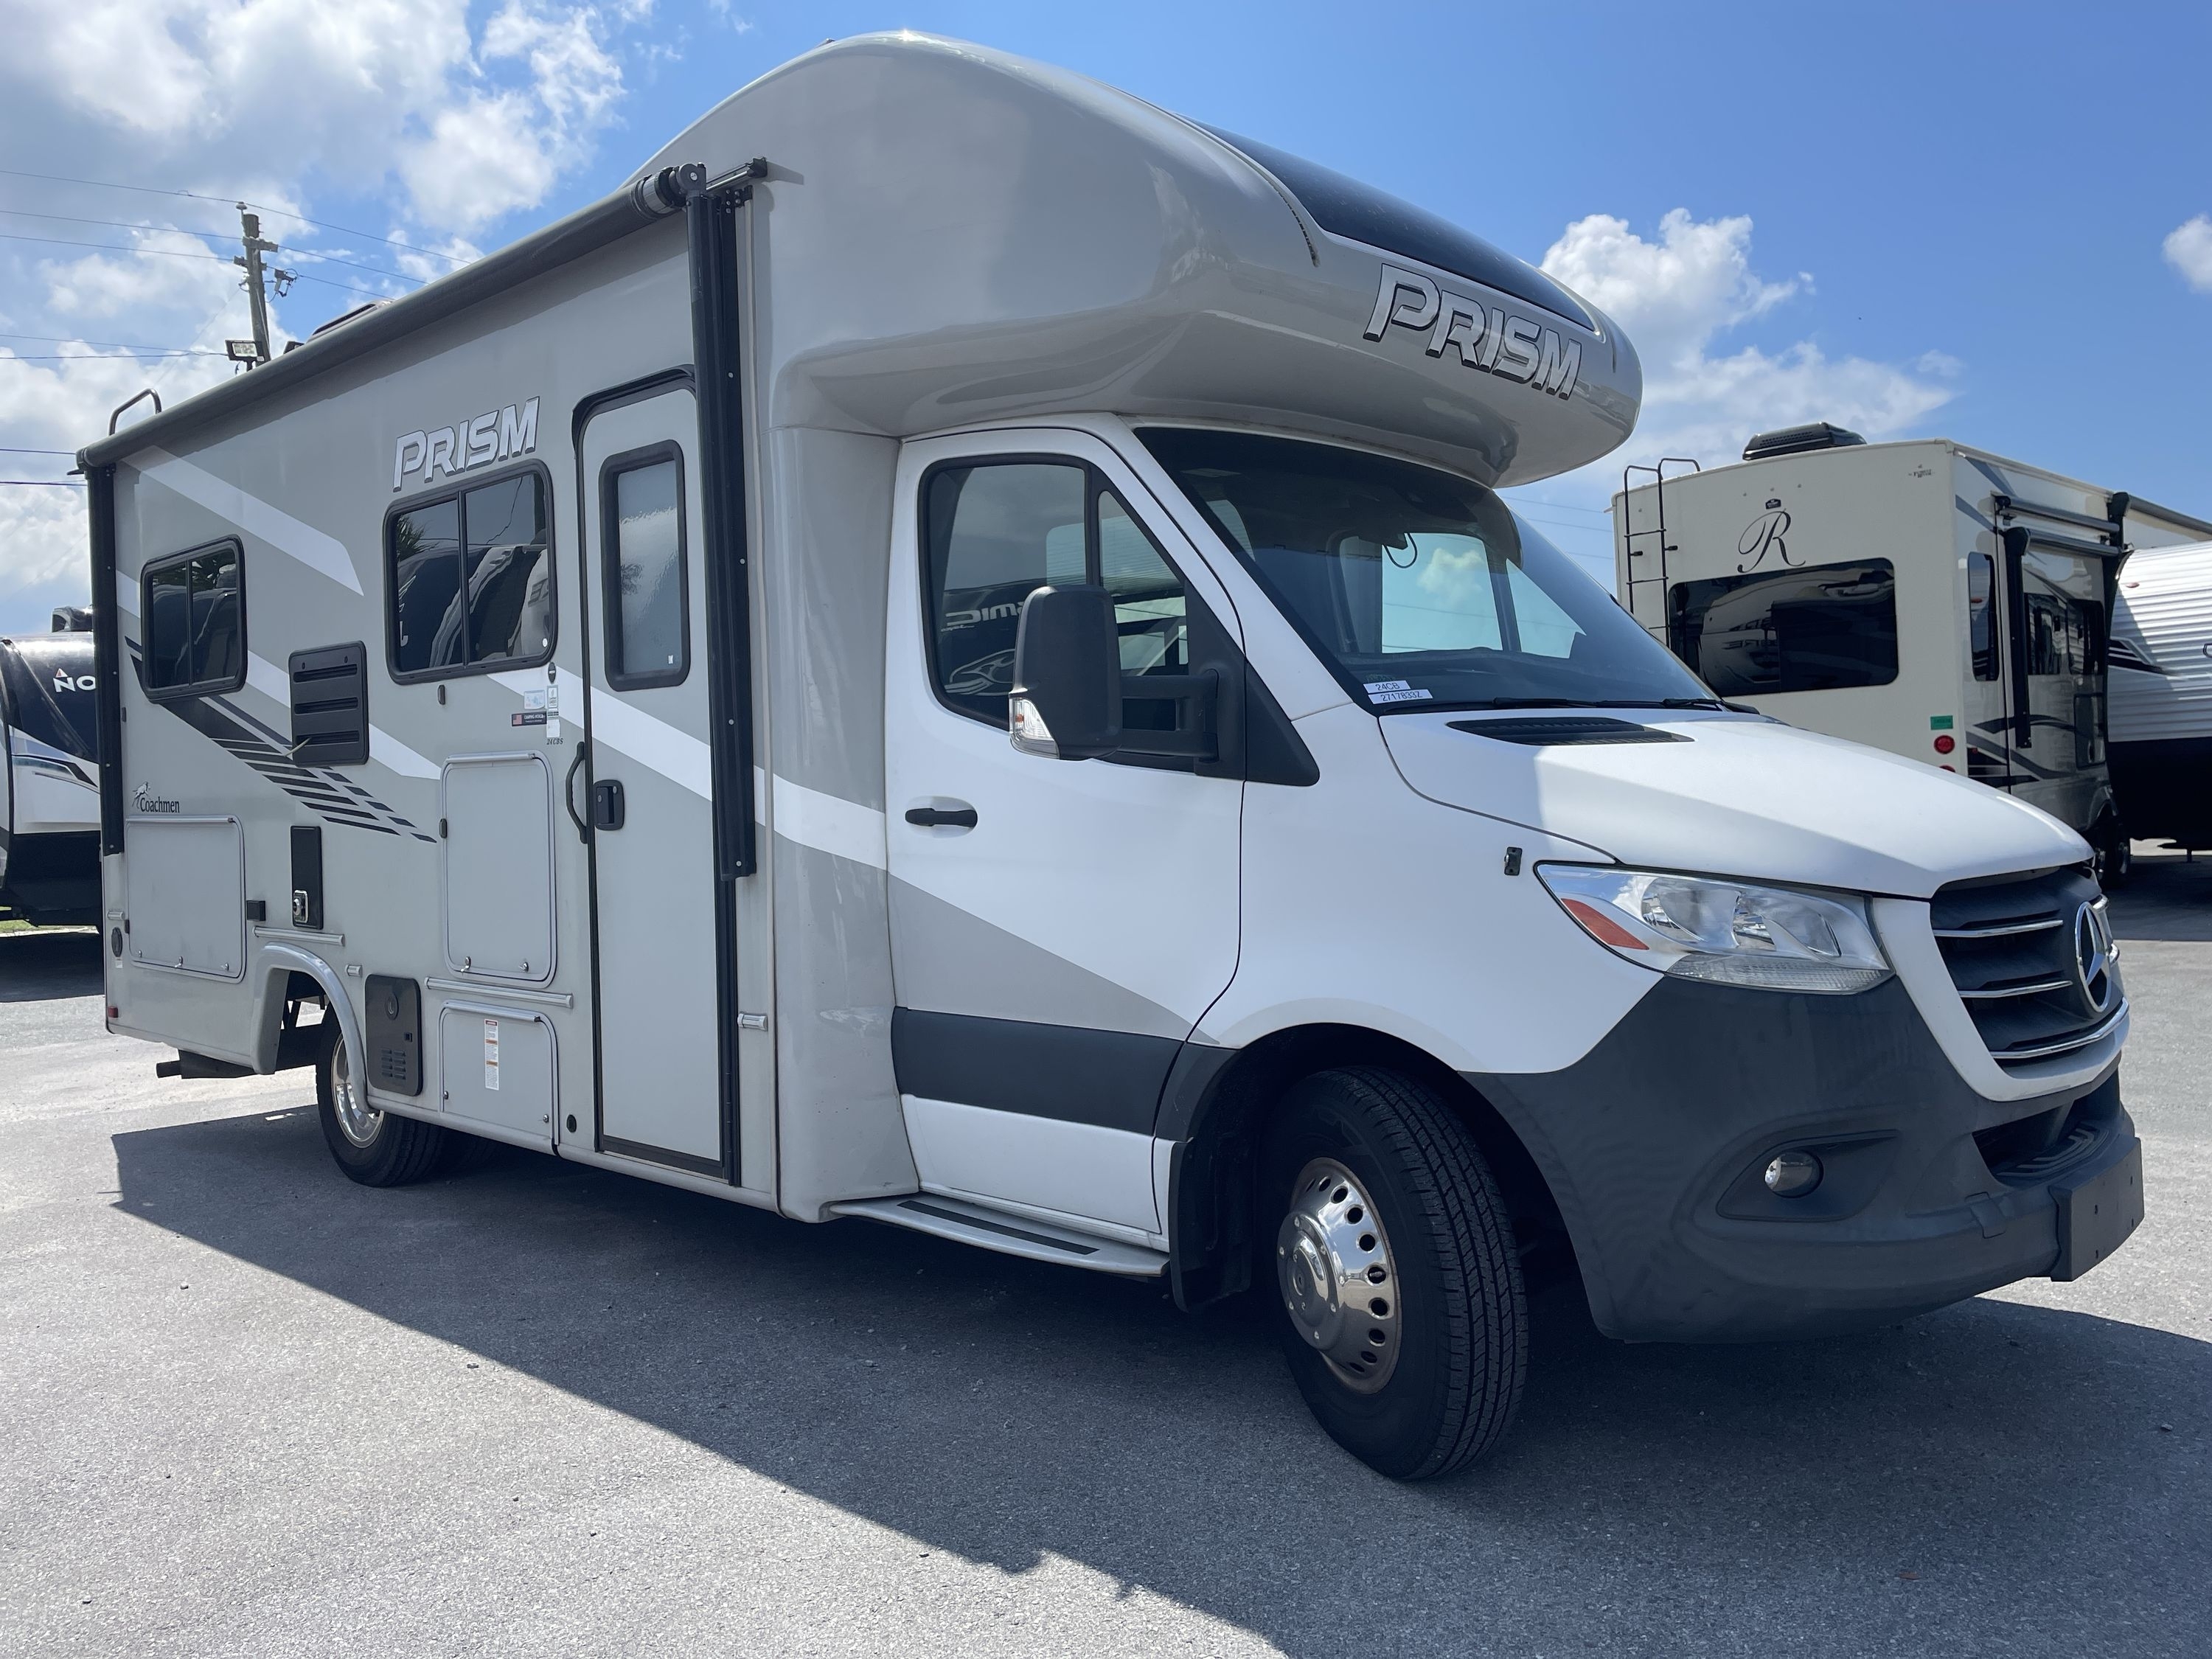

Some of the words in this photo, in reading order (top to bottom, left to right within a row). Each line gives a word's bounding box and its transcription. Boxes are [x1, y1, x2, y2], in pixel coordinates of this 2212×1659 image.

[1363, 262, 1582, 400] PRISM
[393, 396, 540, 493] PRISM
[1737, 509, 1806, 573] R
[1375, 682, 1400, 691] 24CB
[1380, 691, 1422, 701] 2717833Z
[140, 796, 180, 813] Coachmen
